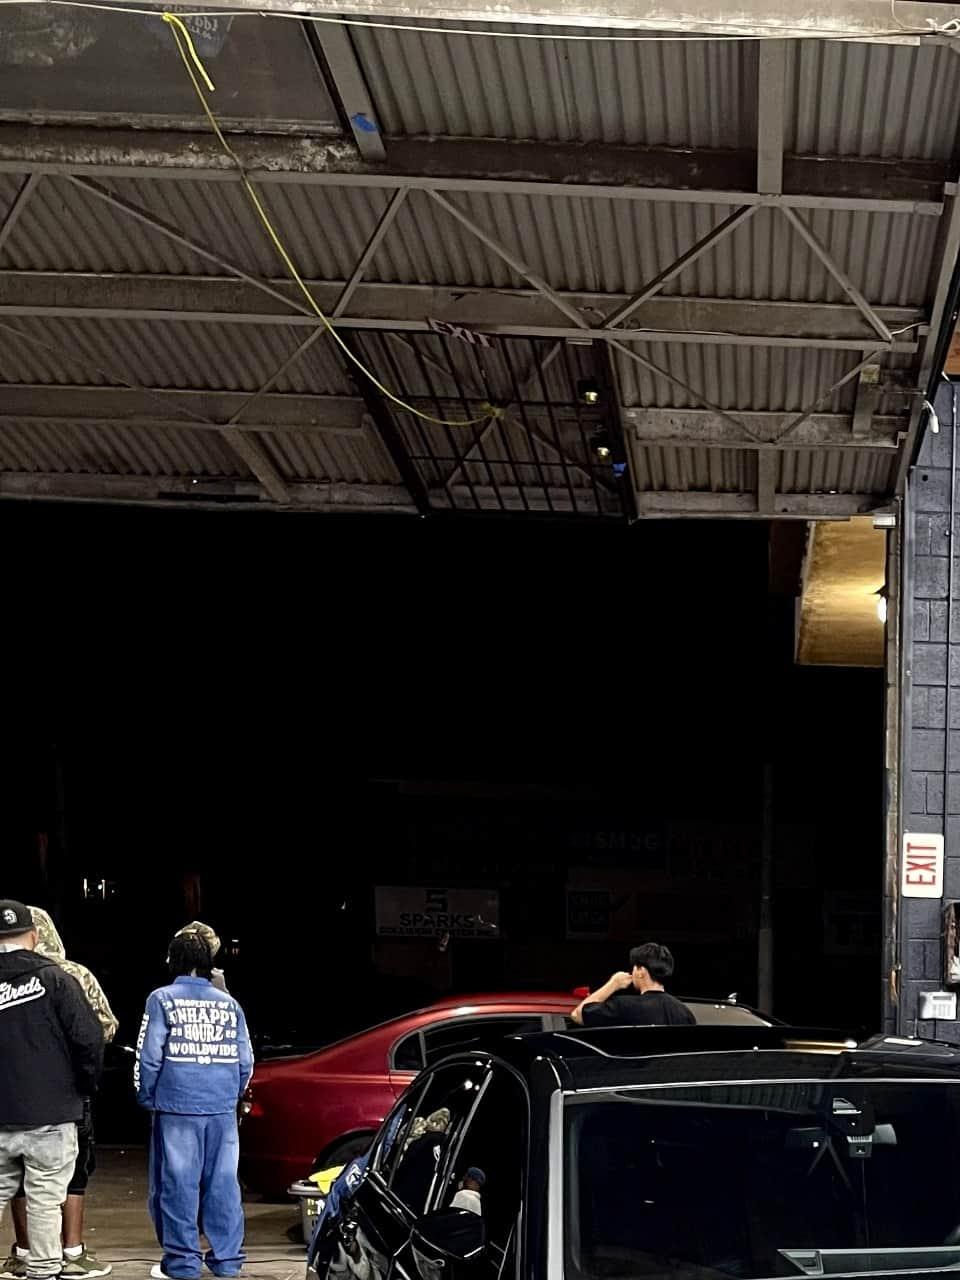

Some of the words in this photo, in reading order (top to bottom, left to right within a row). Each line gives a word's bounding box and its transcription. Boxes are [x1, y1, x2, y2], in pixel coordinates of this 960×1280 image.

[906, 843, 937, 886] EXIT
[184, 1023, 224, 1042] HOURZ
[168, 1042, 238, 1057] WORLDWIDE
